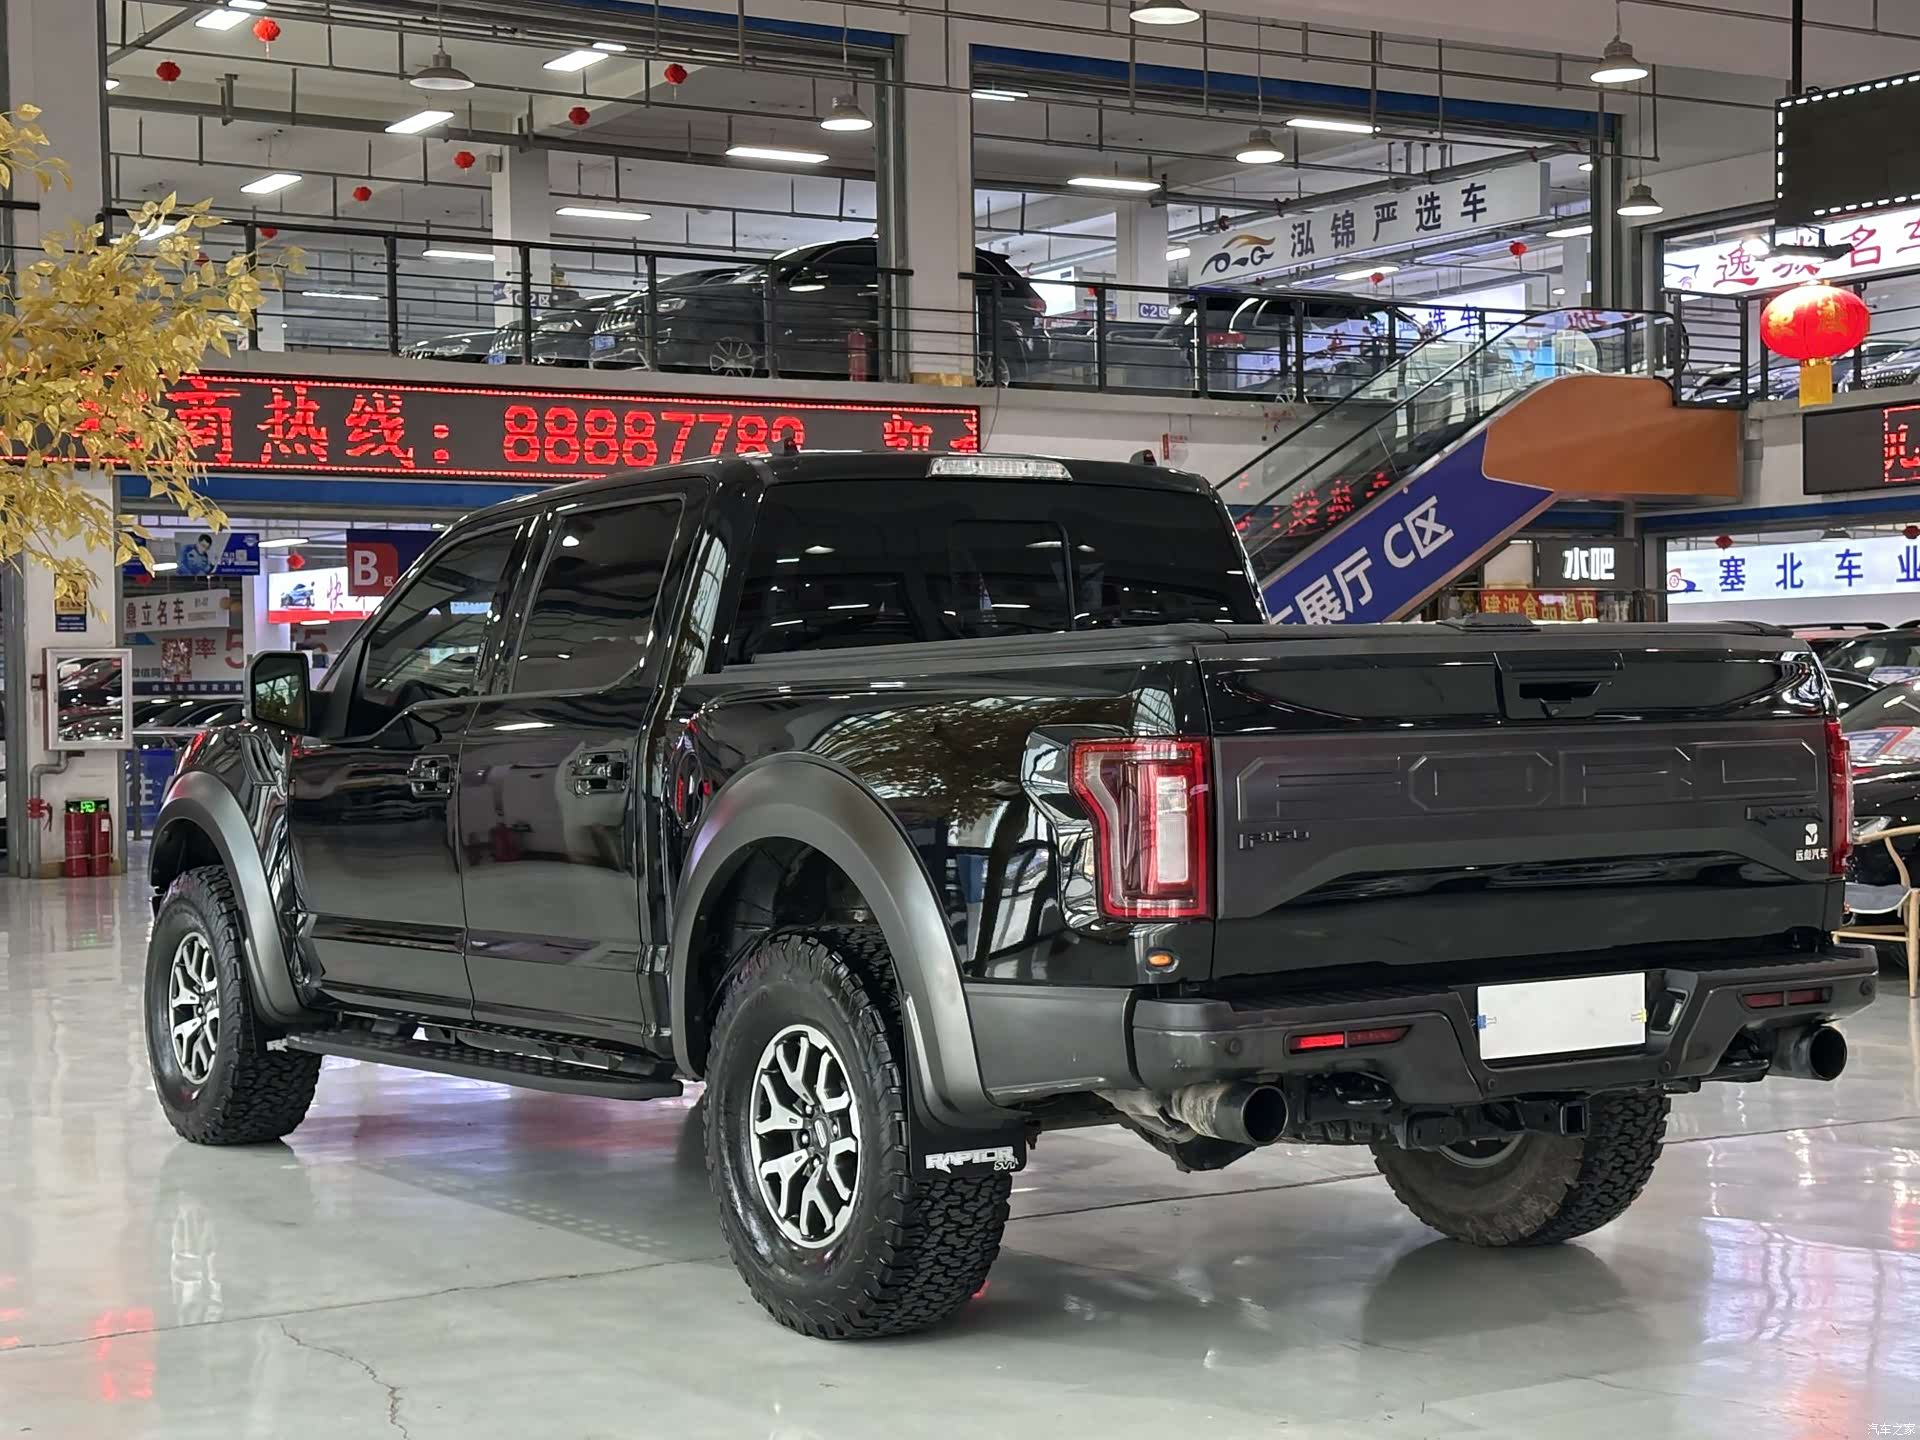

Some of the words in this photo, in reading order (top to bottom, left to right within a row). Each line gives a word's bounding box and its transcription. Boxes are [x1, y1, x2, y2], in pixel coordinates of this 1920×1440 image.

[1291, 182, 1488, 259] 泓锦严选车
[1563, 547, 1615, 580] 水吧
[1719, 546, 1920, 592] 塞北车业
[925, 1146, 1014, 1173] RAPTOR
